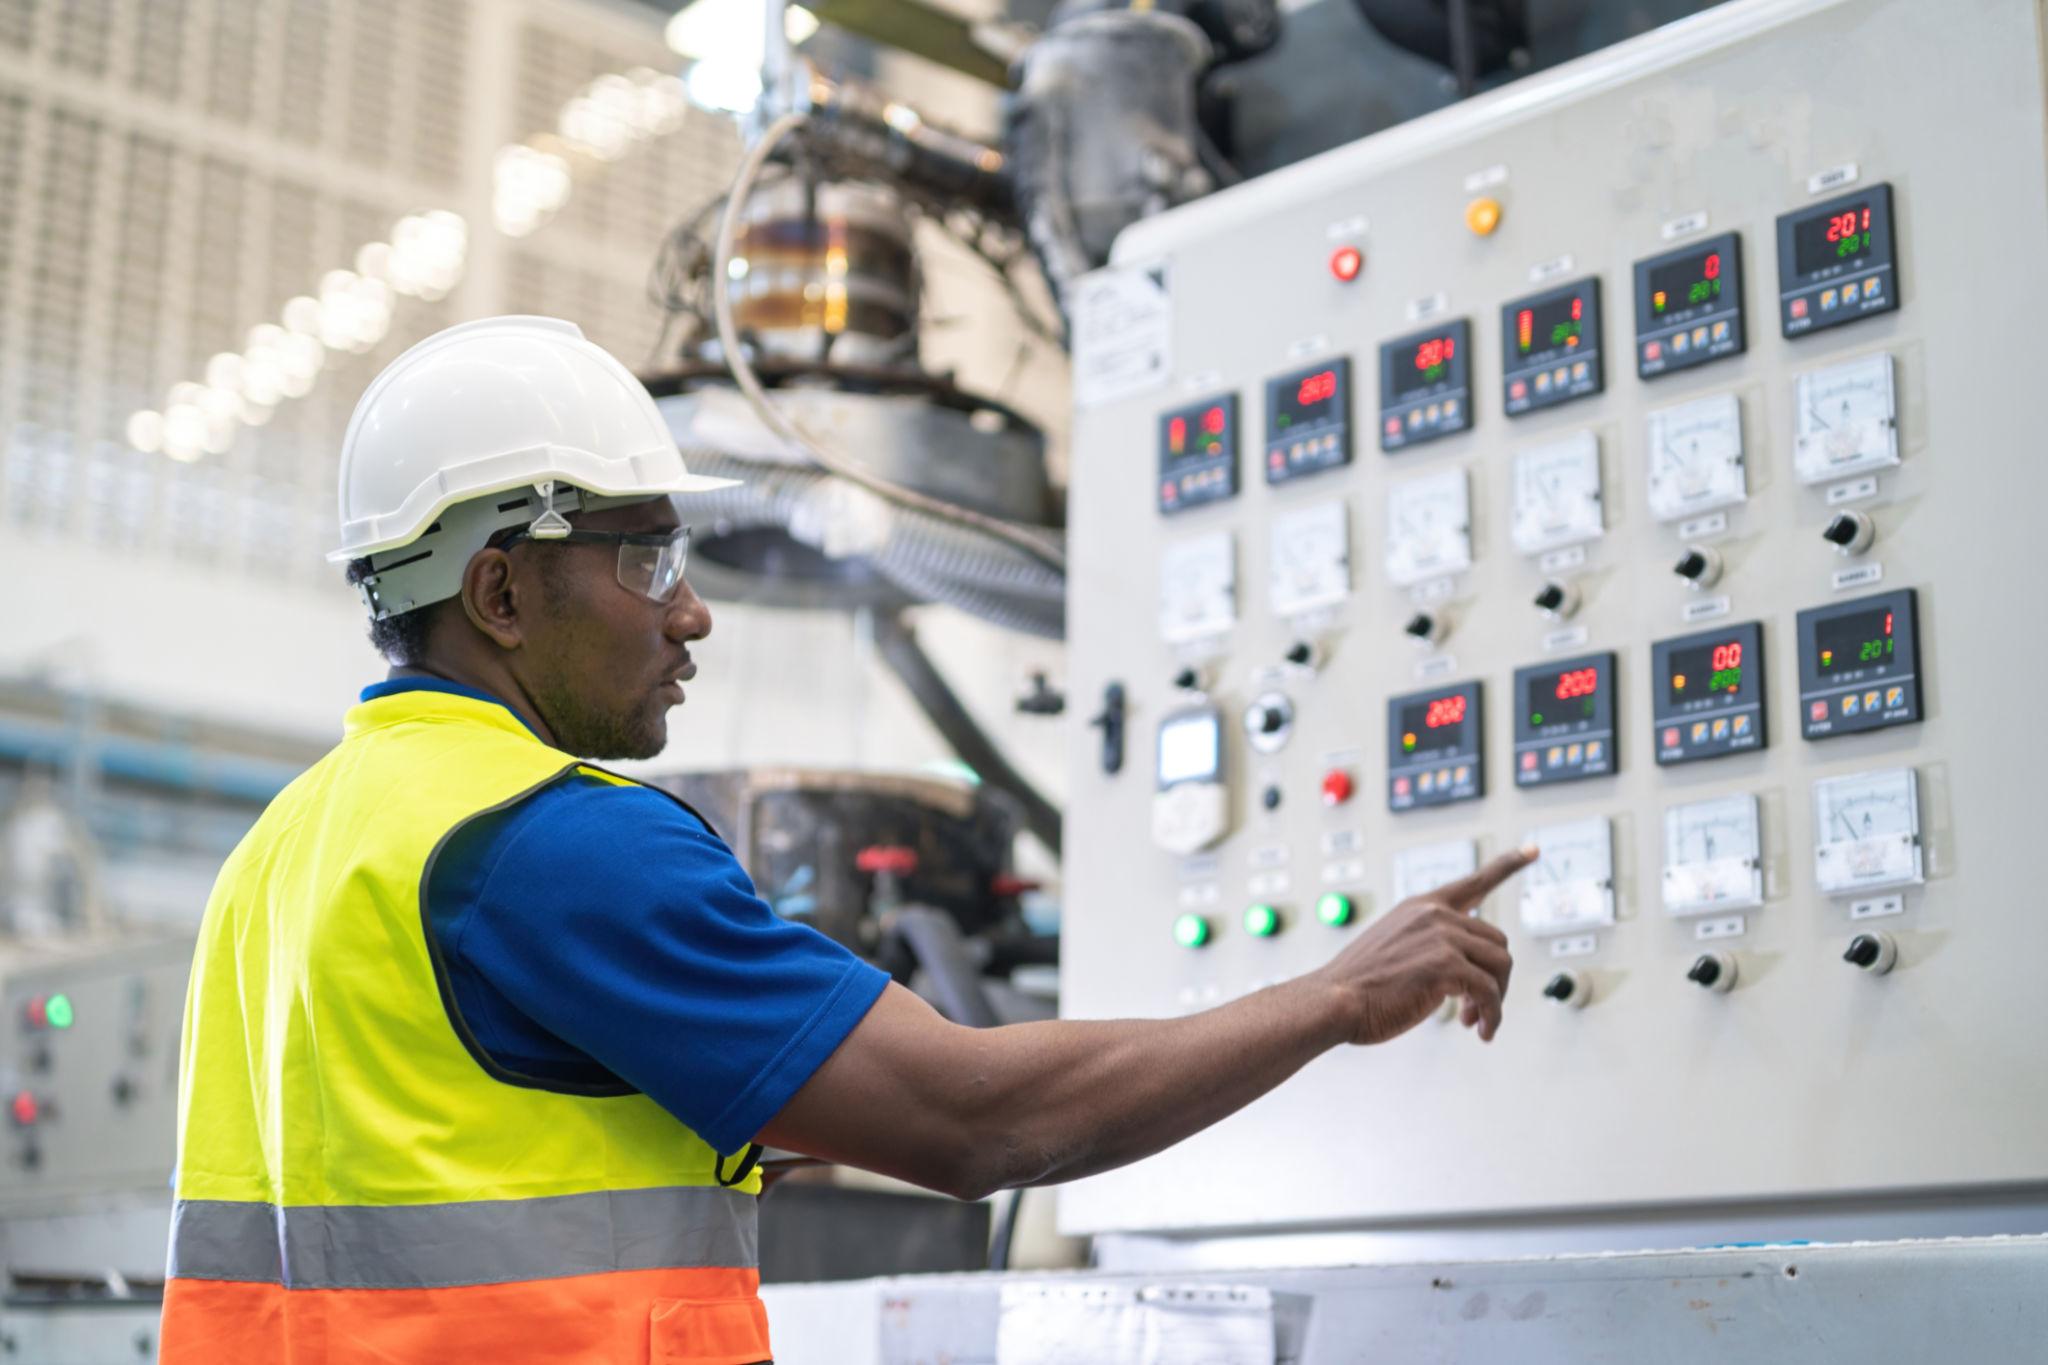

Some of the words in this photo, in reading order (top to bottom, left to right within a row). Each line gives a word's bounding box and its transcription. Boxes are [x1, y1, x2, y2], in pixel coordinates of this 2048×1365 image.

[1826, 207, 1871, 243] 201
[1836, 230, 1871, 257] 201
[1704, 253, 1721, 281] 0
[1884, 612, 1894, 636] 1
[1711, 641, 1743, 672] 00
[1858, 637, 1894, 661] 201
[1555, 666, 1598, 700] 200
